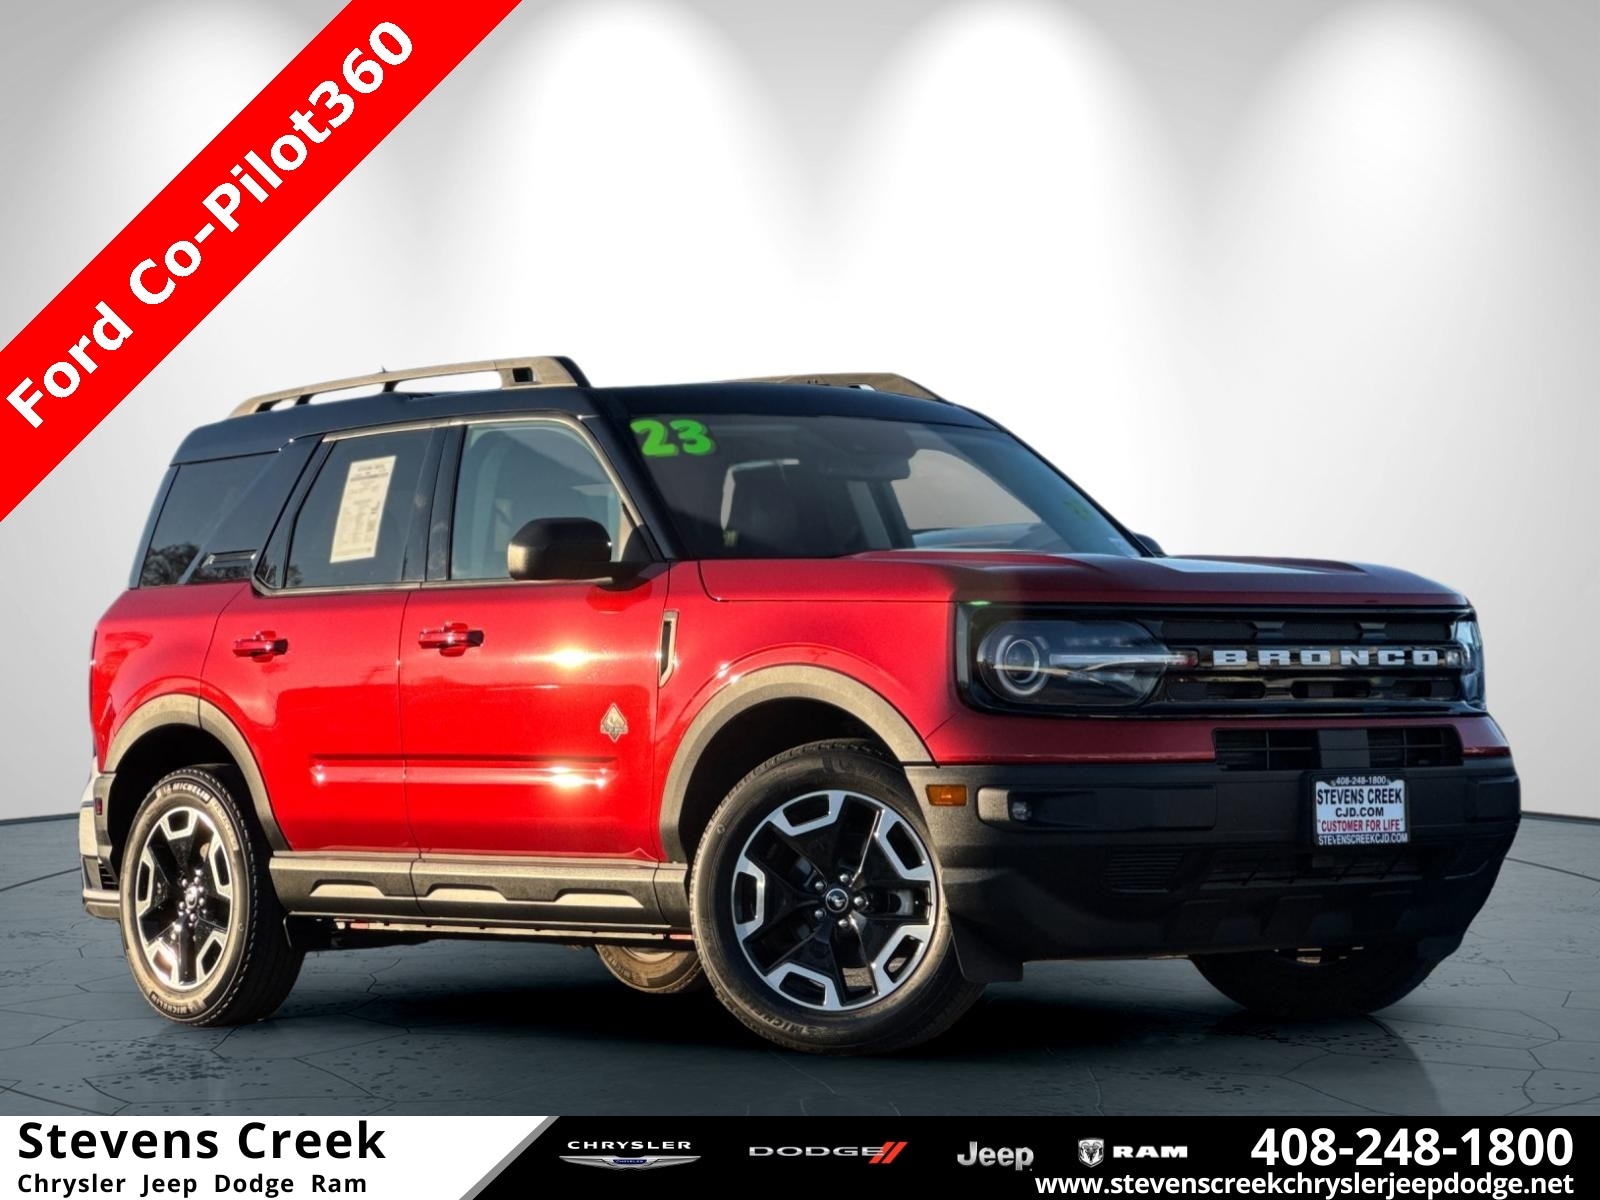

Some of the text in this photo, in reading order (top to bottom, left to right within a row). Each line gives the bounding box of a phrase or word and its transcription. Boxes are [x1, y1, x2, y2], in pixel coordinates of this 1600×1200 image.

[630, 419, 714, 456] 23
[1212, 650, 1438, 666] BRONCO
[1317, 788, 1402, 805] STEVENS CREEK
[1335, 807, 1384, 817] CJD.COM
[1366, 819, 1380, 831] FOR
[1319, 833, 1408, 845] STEVENSCREEKCJD.COM
